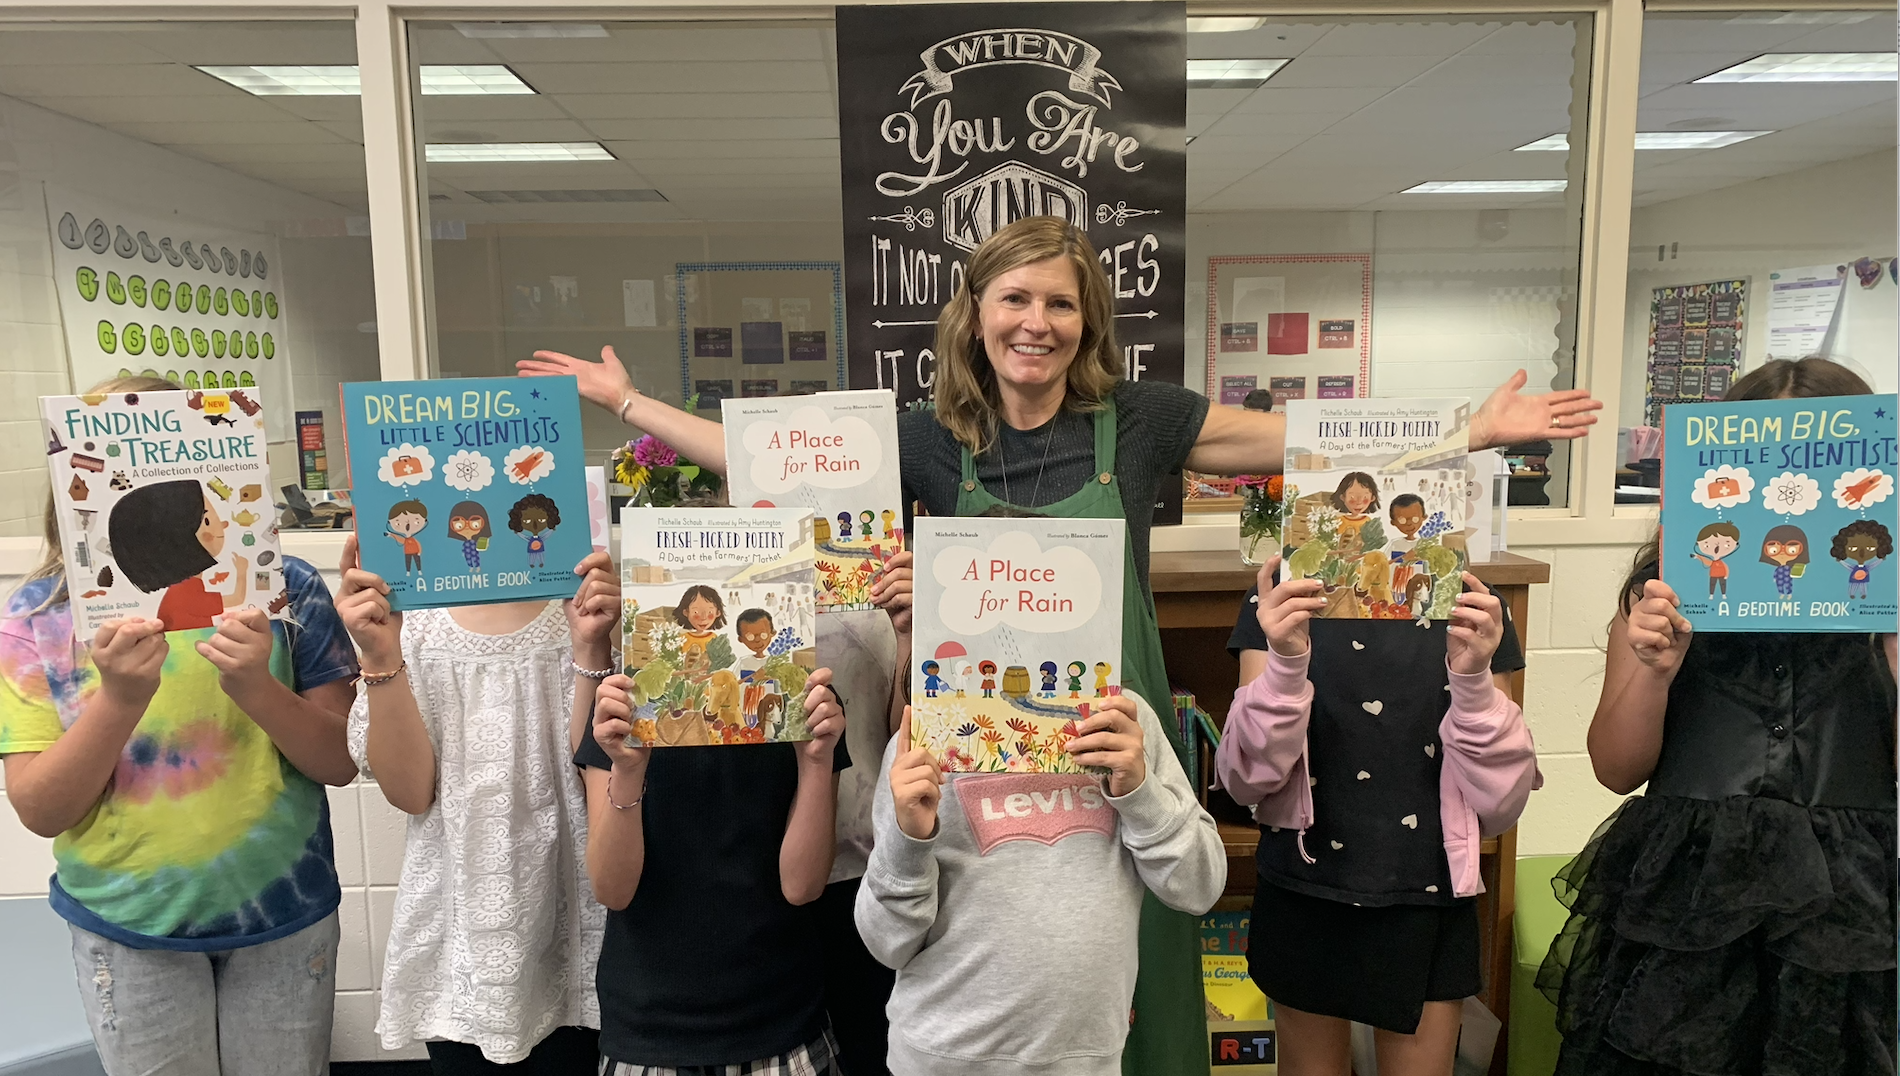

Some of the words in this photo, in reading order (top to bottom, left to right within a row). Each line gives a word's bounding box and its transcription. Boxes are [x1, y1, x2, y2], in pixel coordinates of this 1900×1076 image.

[942, 33, 1078, 66] WHEN
[876, 98, 1016, 196] You
[1026, 90, 1144, 178] Are
[954, 178, 1076, 244] KIND
[872, 235, 890, 306] IT
[900, 244, 941, 306] NOT
[875, 350, 904, 397] IT
[364, 394, 453, 424] DREAM
[462, 390, 520, 419] BIG,
[1396, 408, 1408, 416] Amy
[1410, 409, 1438, 417] Huntington
[65, 409, 182, 438] FINDING
[381, 425, 445, 445] LITTLE
[453, 417, 559, 447] SCIENTISTS
[1319, 421, 1398, 438] FRESH-PICKED
[1402, 421, 1440, 437] POETRY
[1687, 415, 1782, 446] DREAM
[1791, 410, 1860, 439] BIG,
[121, 435, 257, 466] TREASURE
[767, 431, 782, 449] A
[790, 430, 843, 448] Place
[1320, 441, 1326, 449] A
[1328, 442, 1344, 452] Day
[1408, 441, 1436, 451] Market
[780, 456, 807, 480] for
[815, 454, 860, 472] Rain
[1699, 447, 1769, 466] LITTLE
[133, 469, 140, 478] A
[142, 466, 191, 478] Collection
[194, 464, 204, 474] of
[207, 462, 258, 473] Collections
[738, 518, 751, 526] Amy
[752, 518, 782, 527] Huntington
[657, 531, 740, 548] FRESH-PICKED
[746, 531, 785, 548] POETRY
[659, 551, 666, 560] A
[668, 553, 684, 563] Day
[700, 553, 712, 561] the
[752, 553, 782, 563] Market
[417, 578, 426, 592] A
[434, 574, 489, 590] BEDTIME
[498, 571, 531, 586] BOOK
[961, 558, 979, 580] A
[990, 560, 1055, 582] Place
[86, 604, 114, 612] Michelle
[116, 600, 140, 609] Schaub
[974, 590, 1009, 619] for
[1018, 590, 1072, 612] Rain
[1718, 602, 1729, 617] A
[1738, 602, 1800, 617] BEDTIME
[1810, 602, 1849, 617] BOOK
